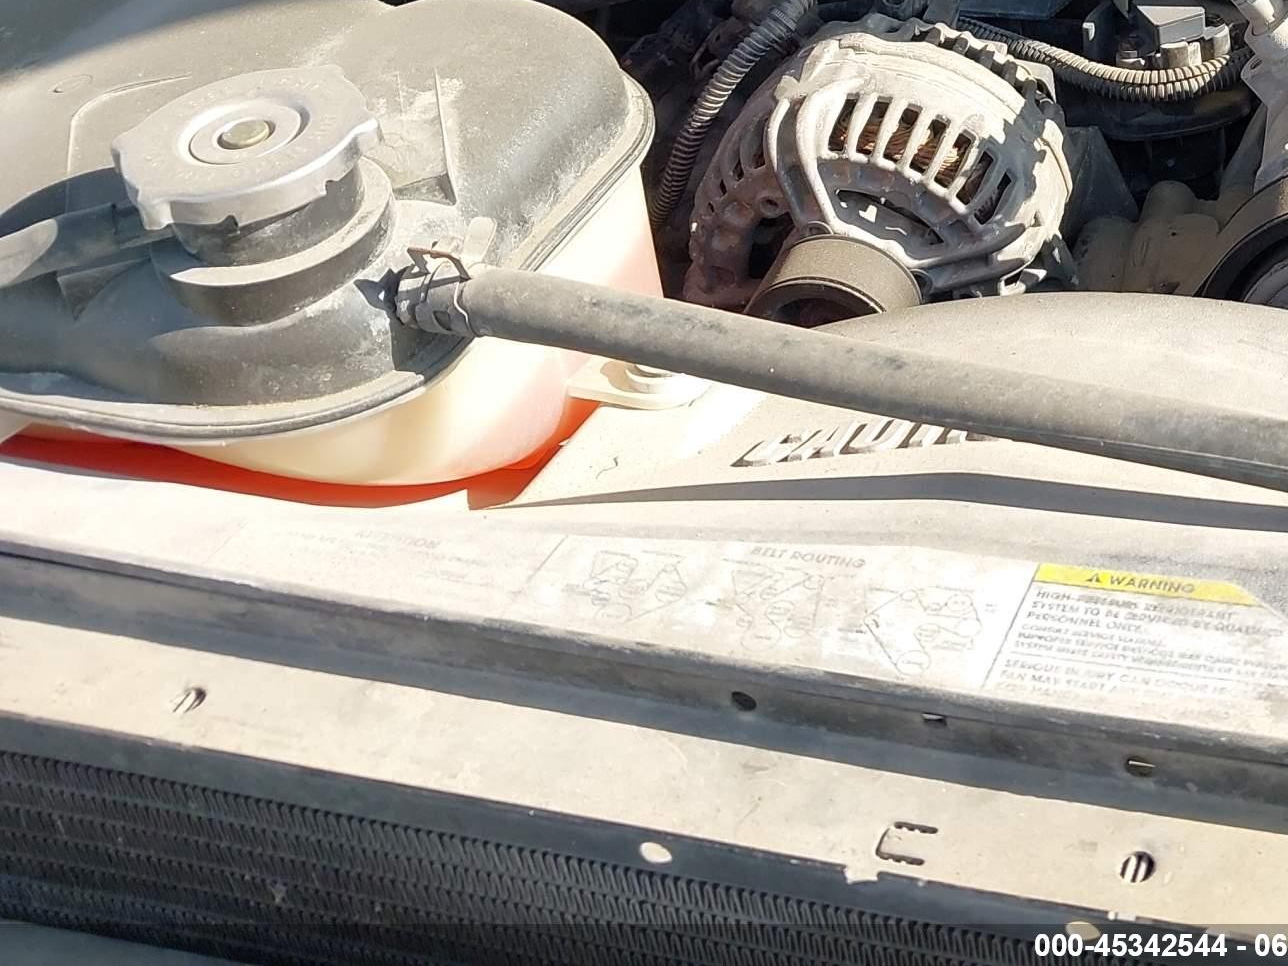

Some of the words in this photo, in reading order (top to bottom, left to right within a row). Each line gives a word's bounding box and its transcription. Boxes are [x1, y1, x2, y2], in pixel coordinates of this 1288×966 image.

[749, 545, 788, 560] BELT
[788, 550, 867, 569] ROUTING
[1110, 575, 1196, 594] WARNING
[1084, 607, 1100, 617] TO
